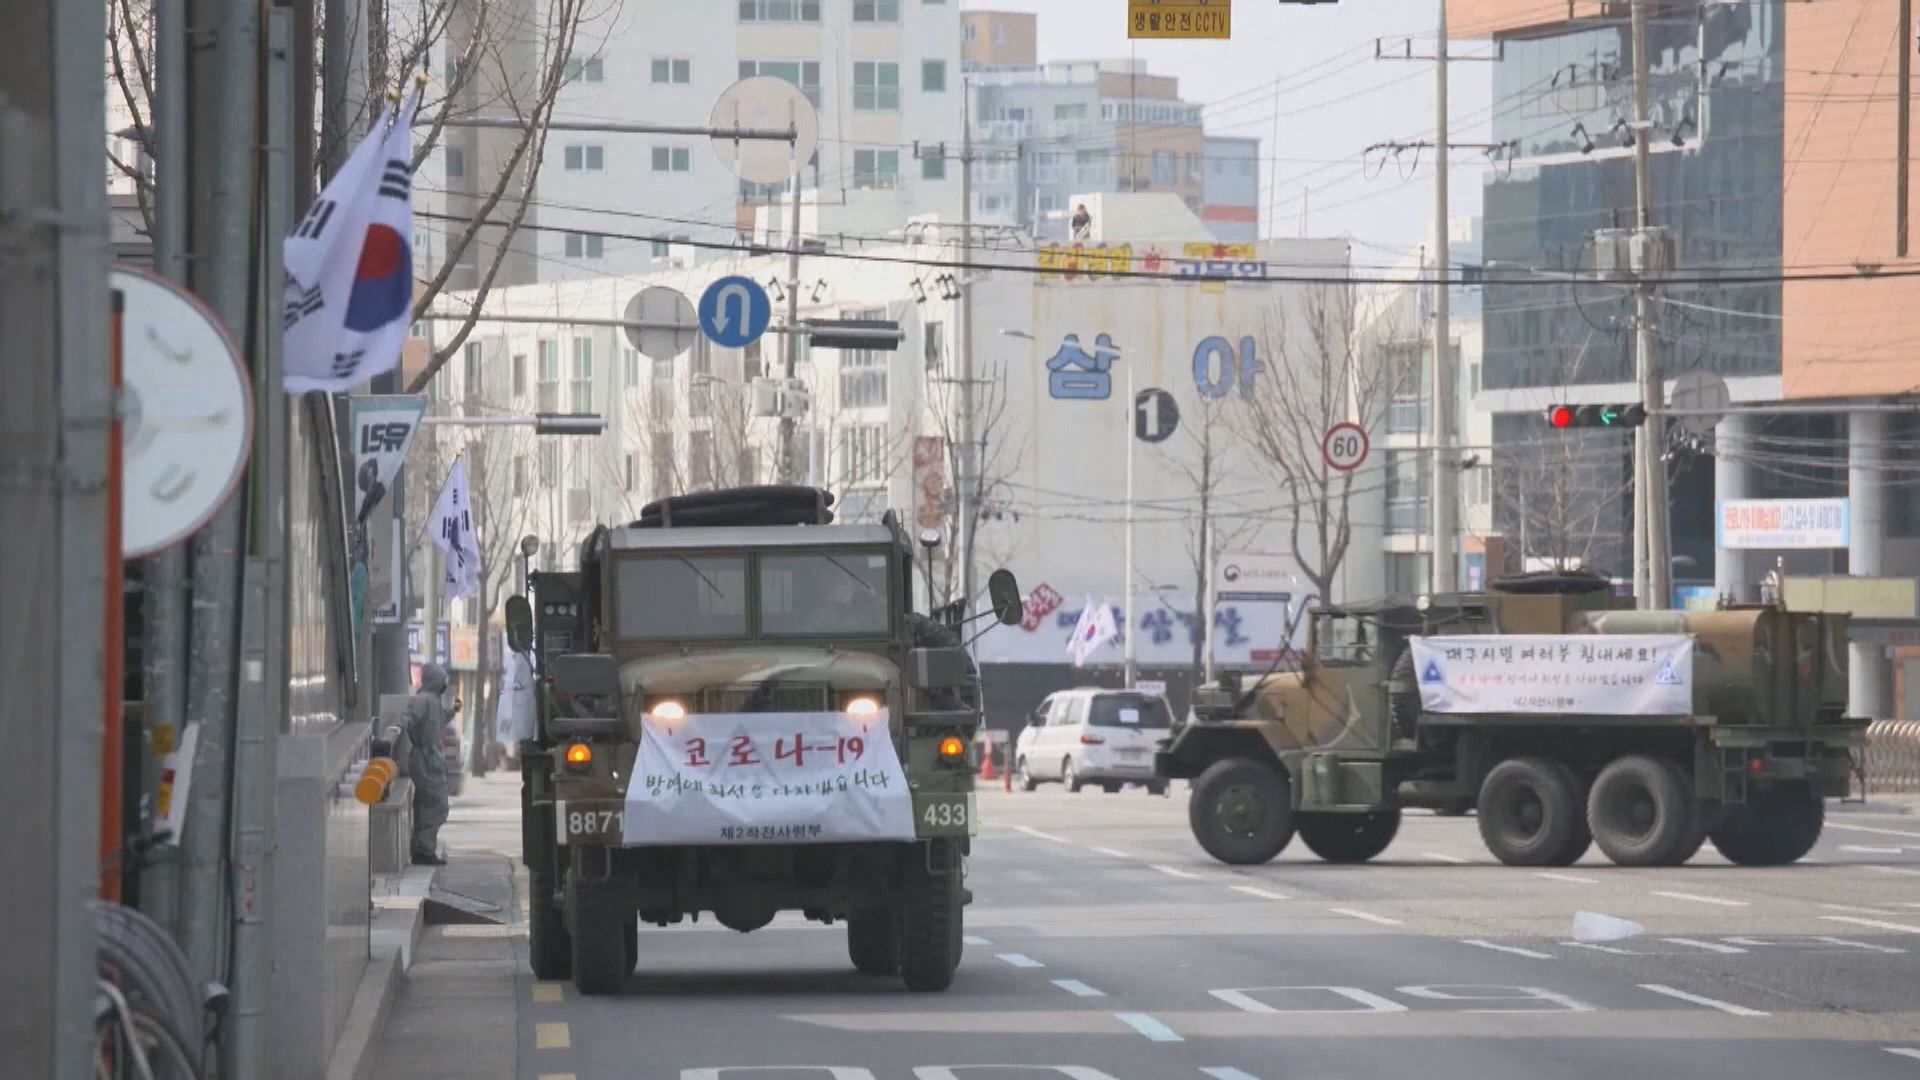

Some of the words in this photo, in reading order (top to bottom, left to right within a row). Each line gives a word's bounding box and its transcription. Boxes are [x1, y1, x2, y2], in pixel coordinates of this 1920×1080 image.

[1333, 436, 1358, 457] 60
[1445, 646, 1513, 664] 대구시민
[1521, 644, 1570, 664] 여러분
[924, 803, 966, 827] 433
